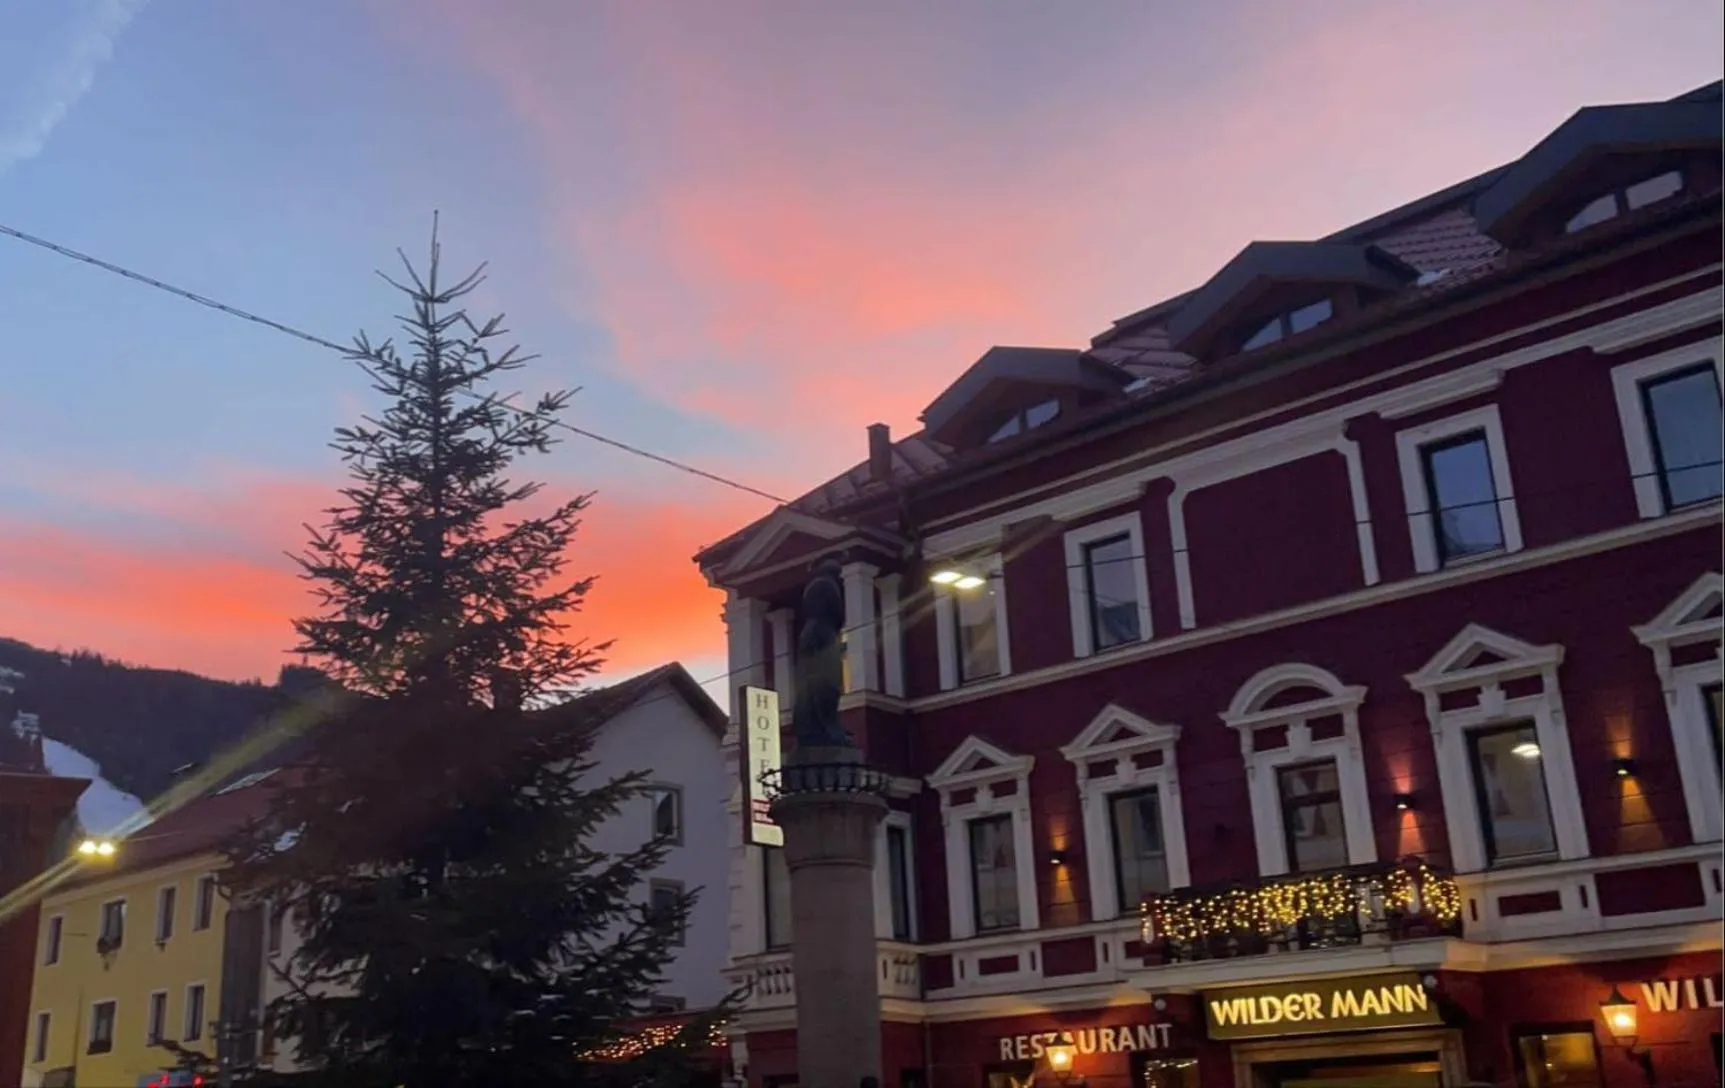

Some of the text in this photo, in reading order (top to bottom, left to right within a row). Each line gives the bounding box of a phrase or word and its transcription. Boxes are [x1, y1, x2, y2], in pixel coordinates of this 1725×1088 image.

[756, 693, 772, 795] HOTE
[1211, 984, 1427, 1026] WILDER MANN
[1640, 978, 1724, 1012] WIL
